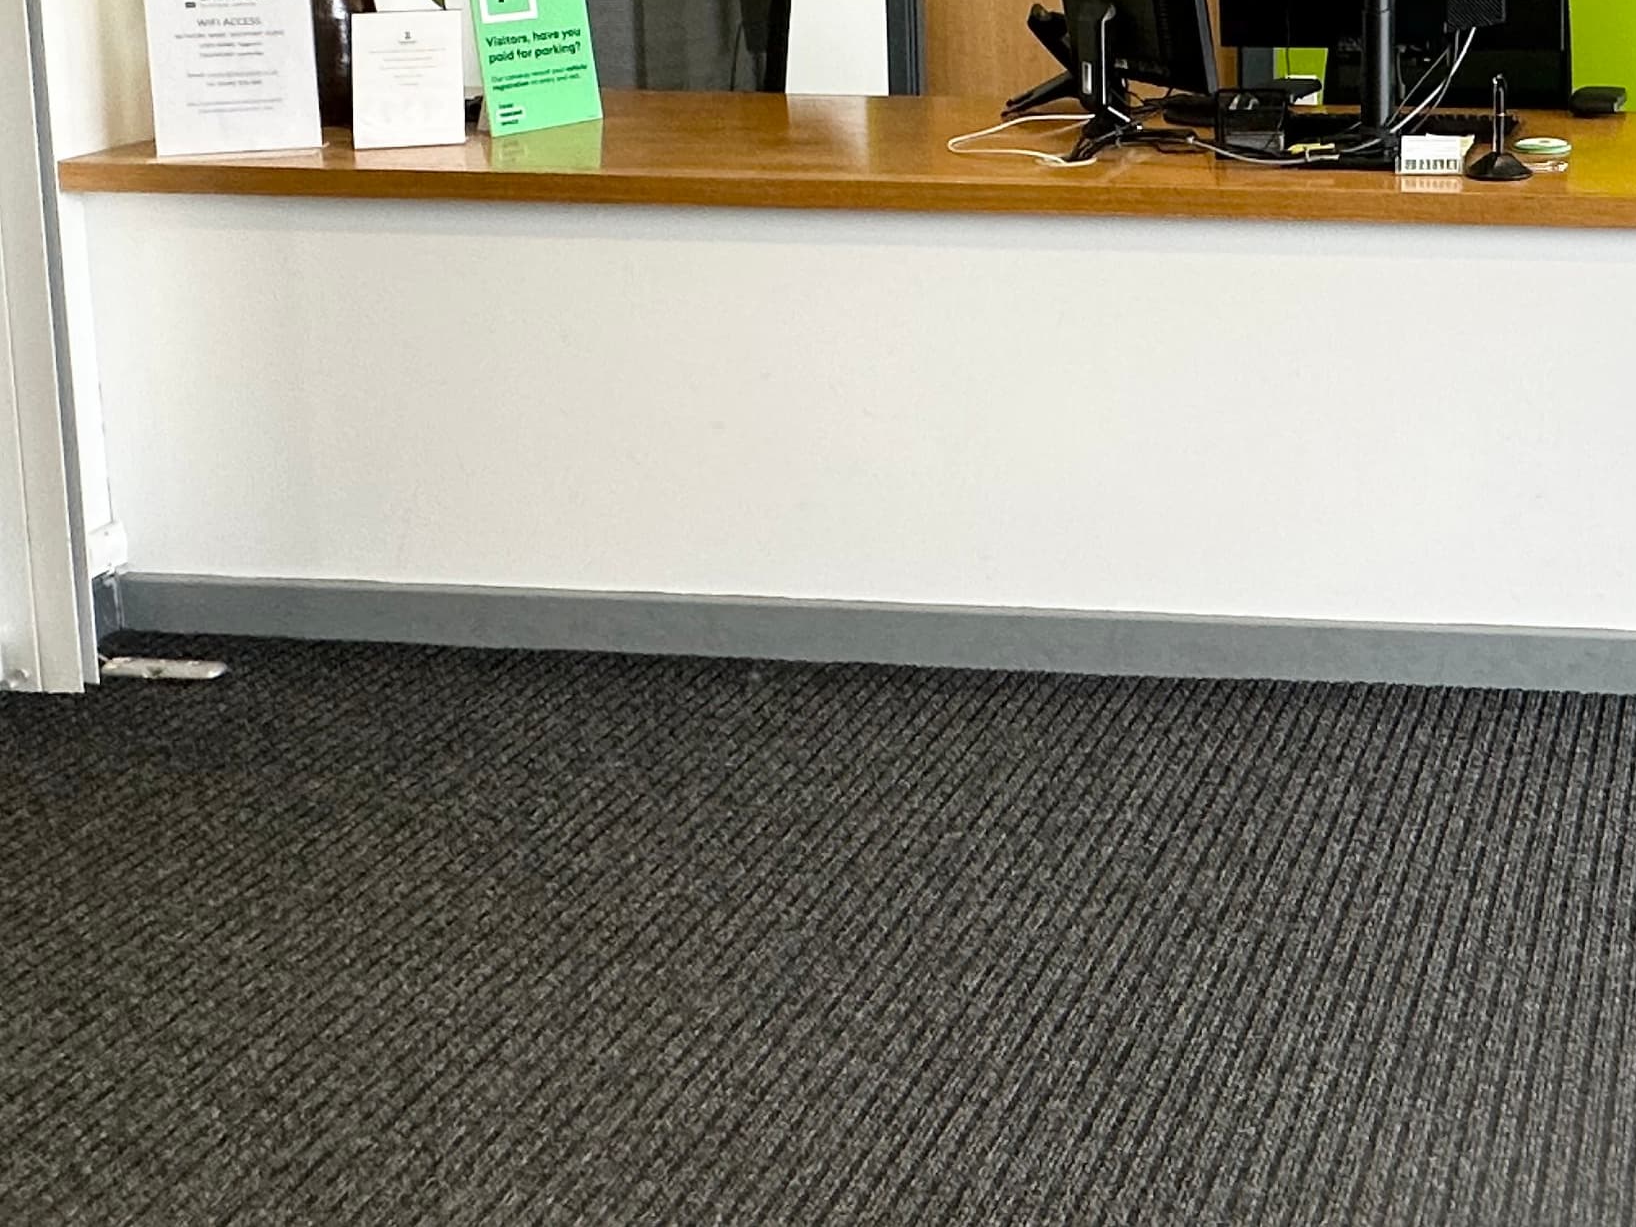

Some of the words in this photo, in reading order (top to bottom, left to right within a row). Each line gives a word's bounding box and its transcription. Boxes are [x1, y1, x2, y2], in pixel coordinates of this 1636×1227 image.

[486, 34, 531, 47] Visitors,
[532, 30, 560, 42] have
[561, 28, 581, 41] you
[488, 50, 515, 65] paid
[516, 48, 533, 59] for
[534, 41, 582, 59] parking?
